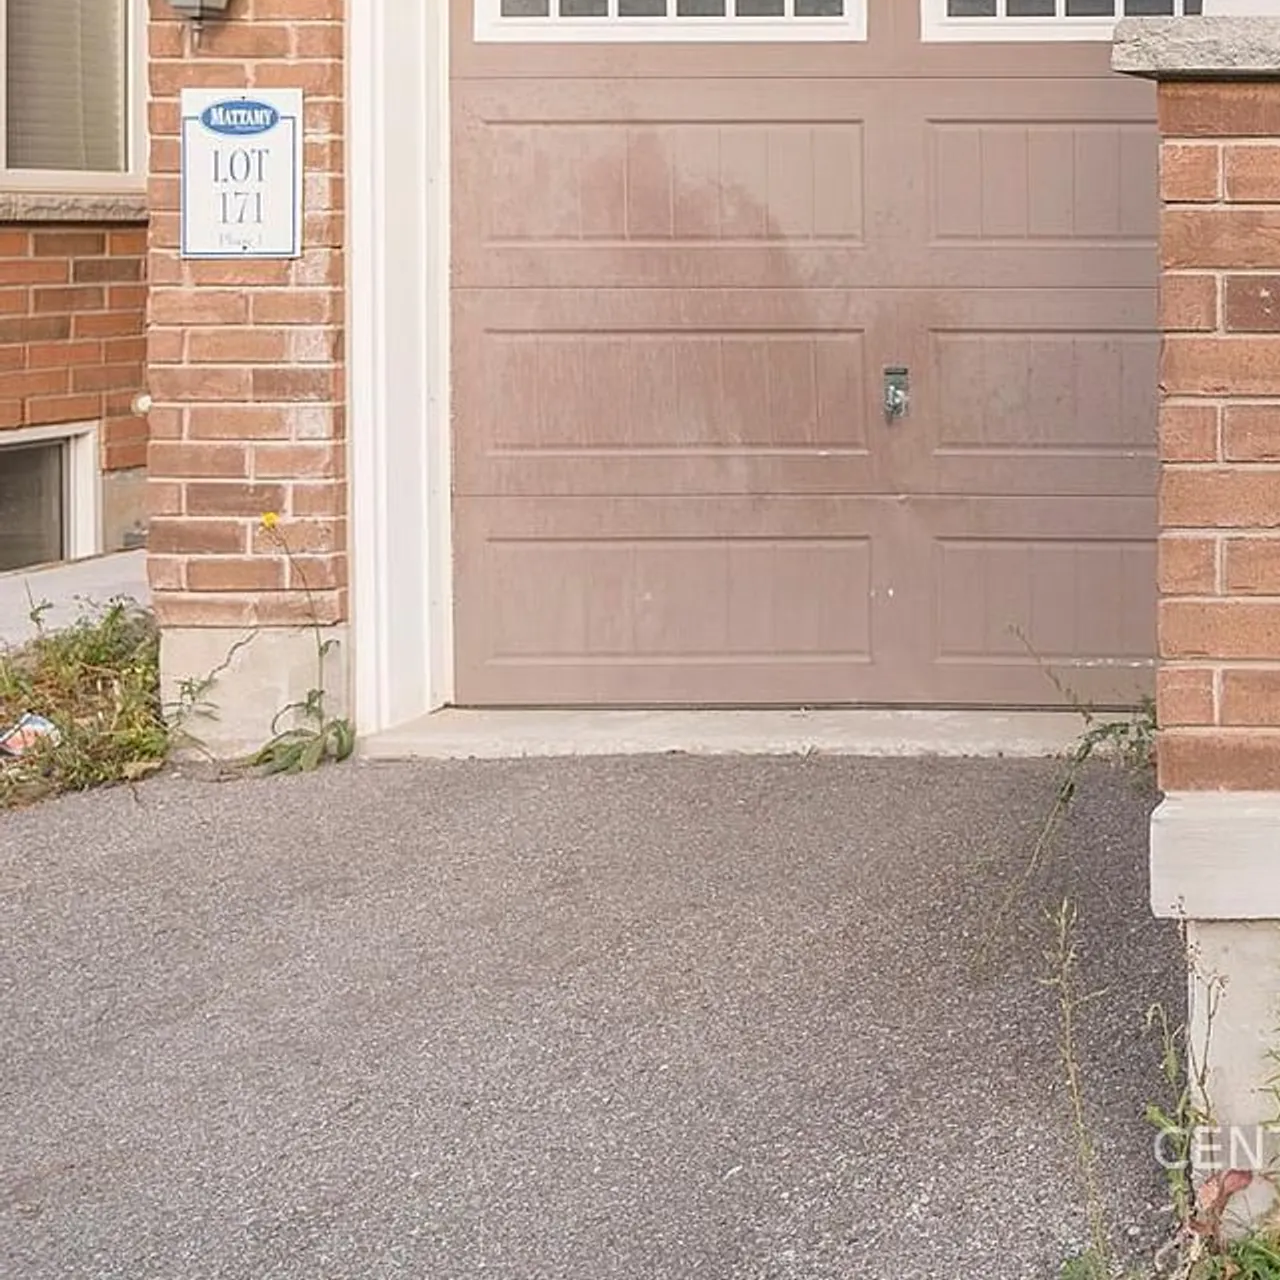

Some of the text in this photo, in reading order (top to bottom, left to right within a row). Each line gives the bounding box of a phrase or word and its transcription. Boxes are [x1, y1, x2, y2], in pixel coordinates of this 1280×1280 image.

[210, 107, 273, 126] MATTAMY
[213, 148, 270, 183] LOT
[219, 191, 263, 225] 171
